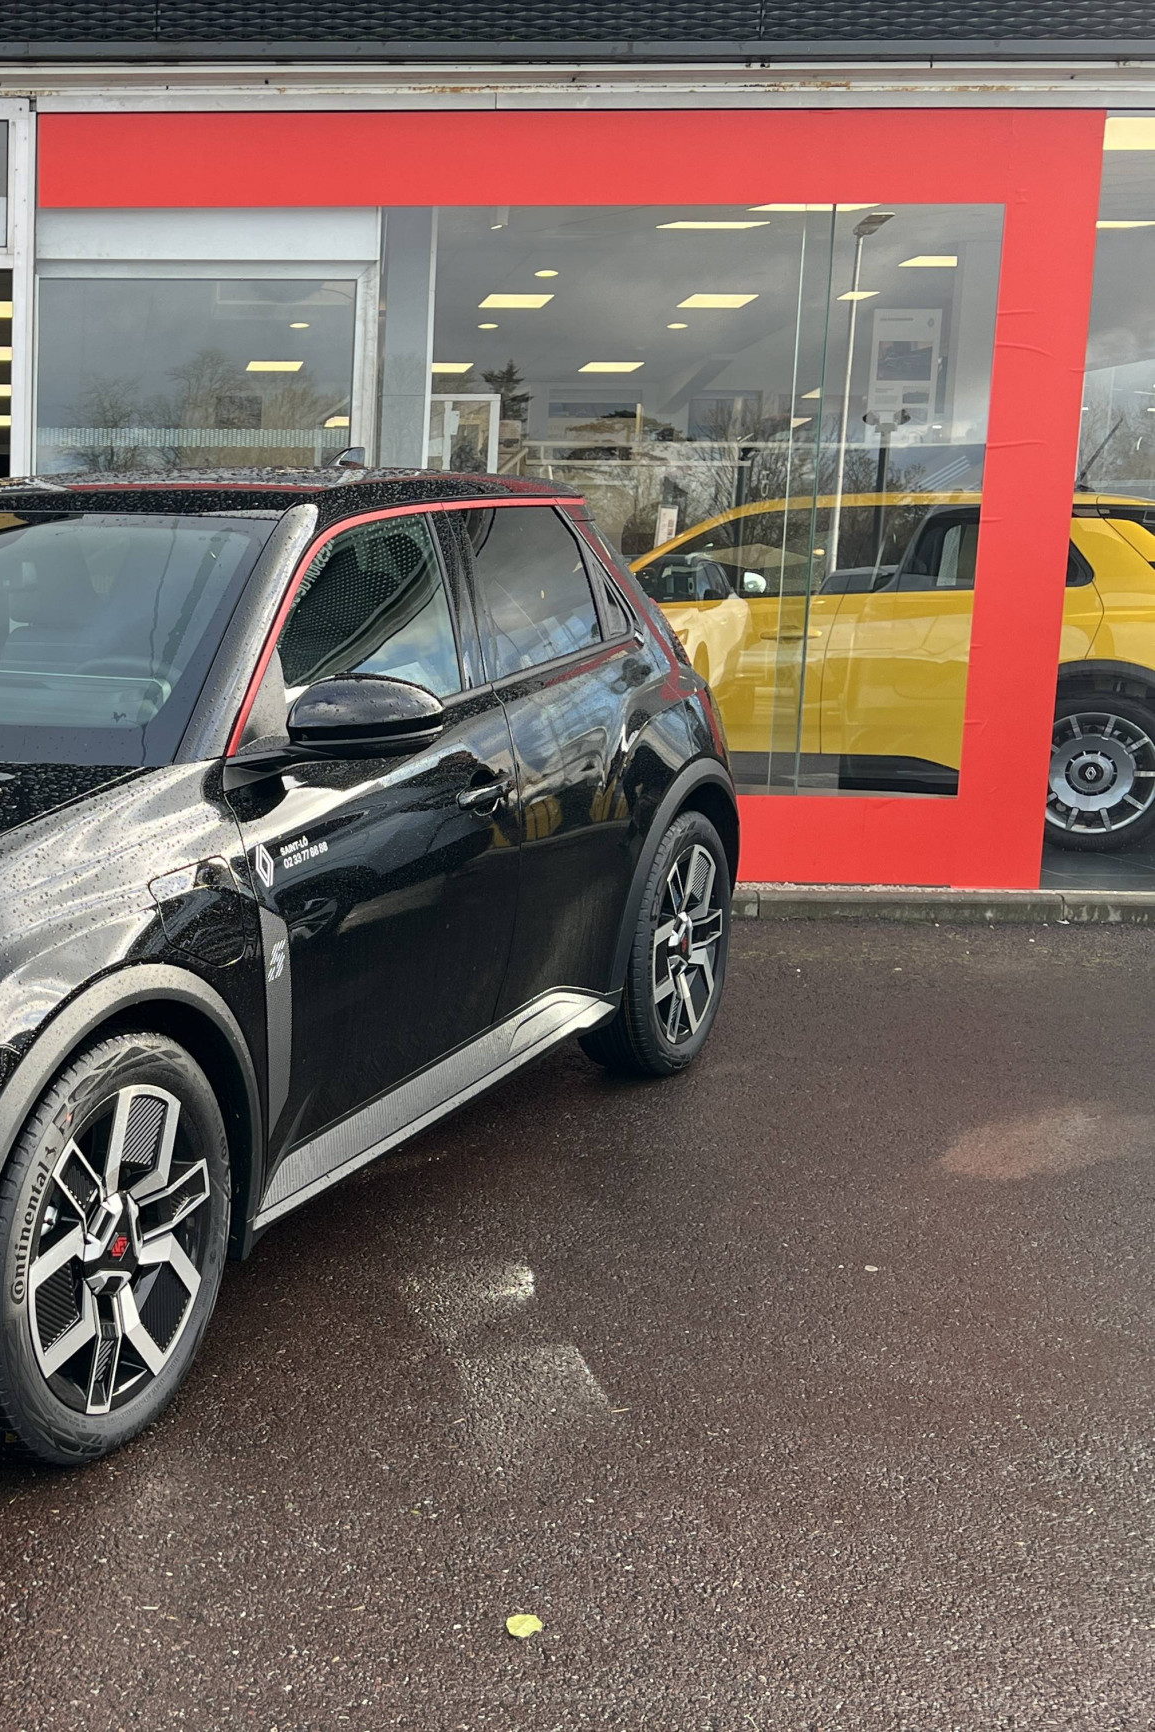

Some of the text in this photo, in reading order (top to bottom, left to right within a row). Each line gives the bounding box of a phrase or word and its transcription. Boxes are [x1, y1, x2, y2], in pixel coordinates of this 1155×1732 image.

[279, 835, 309, 856] SAINT-LÔ
[283, 856, 294, 869] 02
[293, 852, 302, 865] 33
[301, 848, 310, 861] 77
[10, 1160, 50, 1305] Continental
